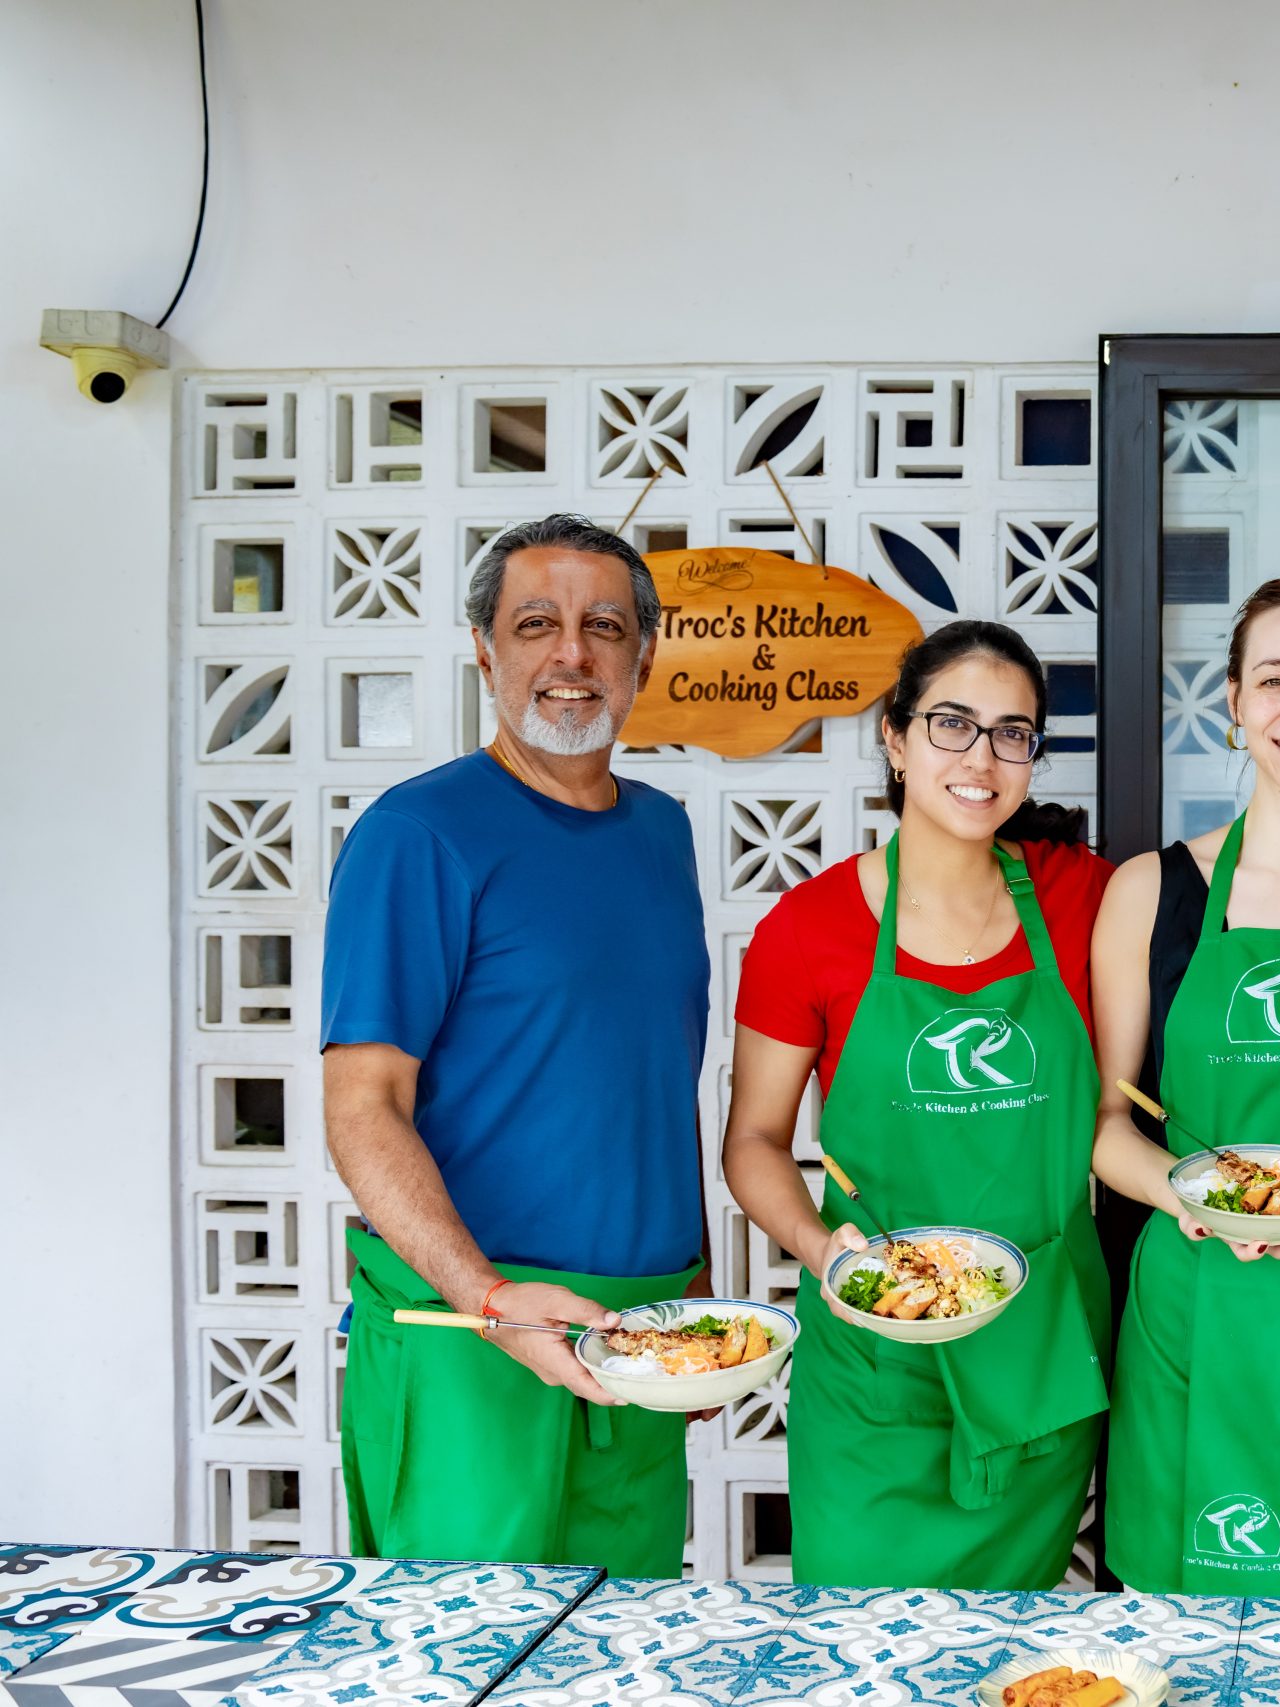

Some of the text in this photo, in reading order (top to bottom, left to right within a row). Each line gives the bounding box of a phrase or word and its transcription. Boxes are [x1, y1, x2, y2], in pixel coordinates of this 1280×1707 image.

[661, 602, 872, 639] Troc's Kitchen
[752, 643, 775, 671] &
[668, 669, 859, 711] Cooking Class
[925, 1102, 967, 1114] Kitchen
[970, 1103, 978, 1113] &
[982, 1098, 1026, 1111] Cooking
[1232, 1563, 1239, 1571] &
